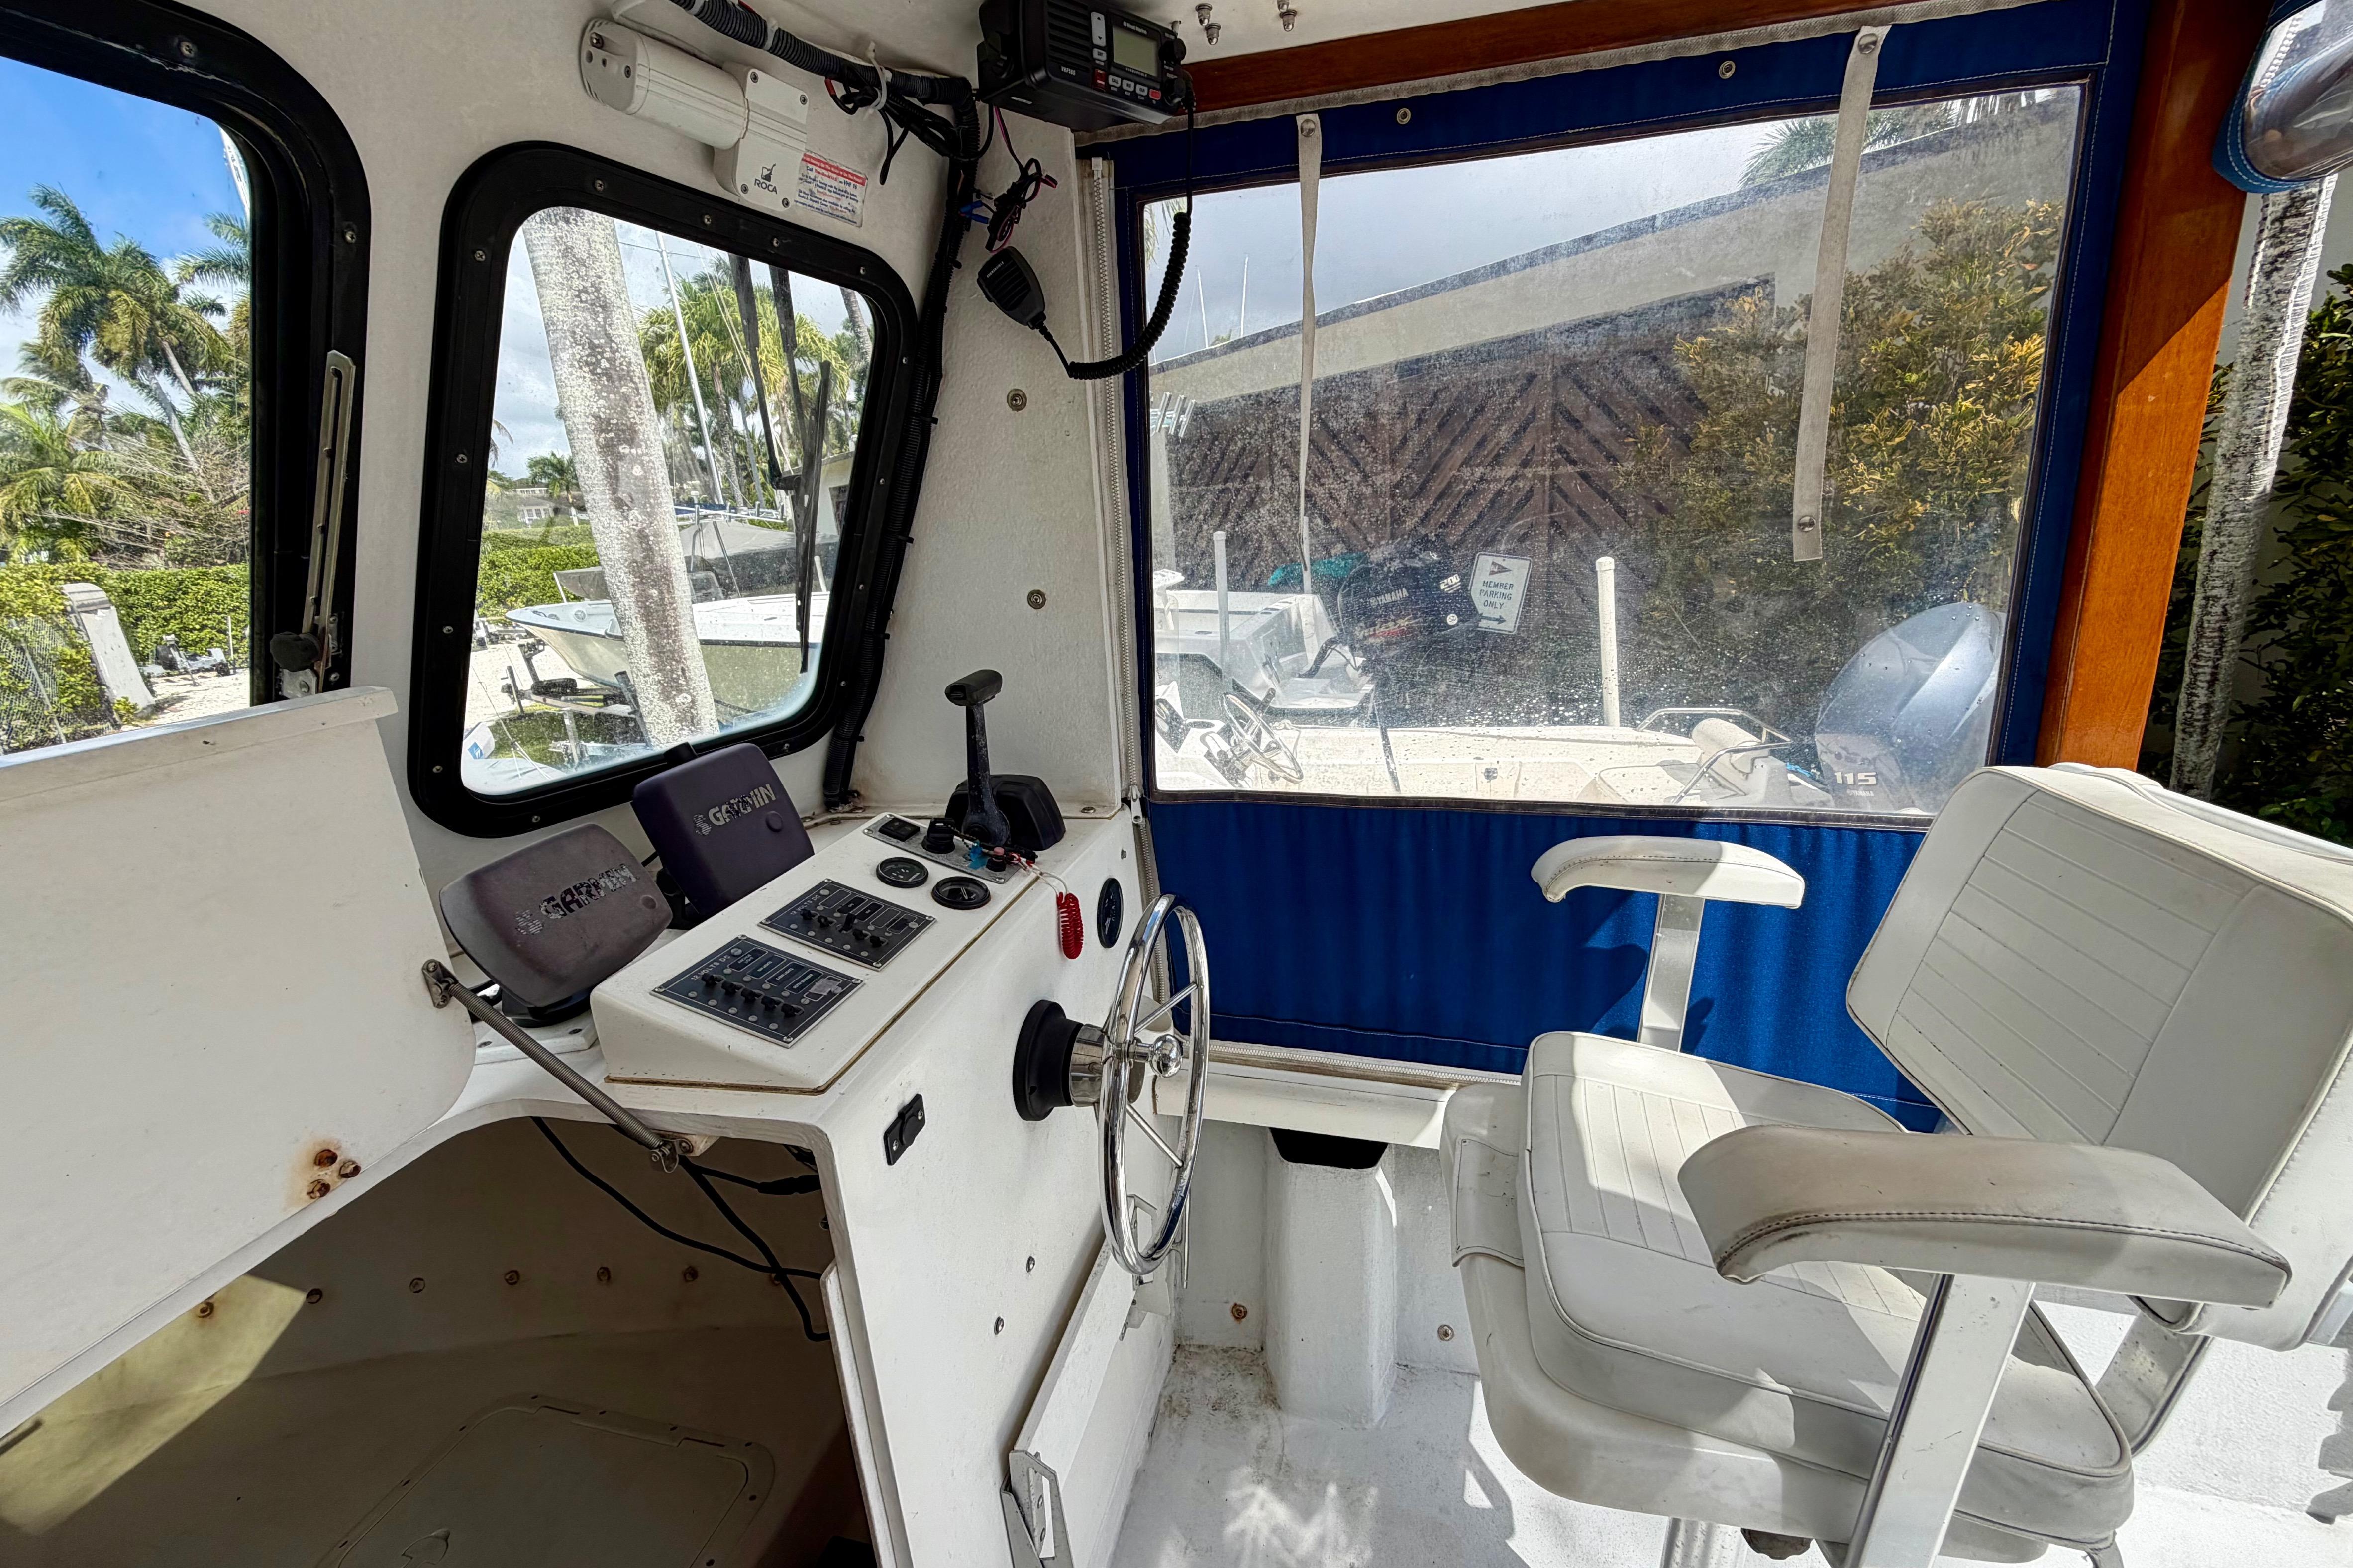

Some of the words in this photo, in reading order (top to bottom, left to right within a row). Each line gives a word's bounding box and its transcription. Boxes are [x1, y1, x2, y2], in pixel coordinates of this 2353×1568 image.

[754, 178, 777, 195] ROCA
[1439, 574, 1461, 589] 200
[1482, 580, 1514, 590] MEMBER
[1376, 588, 1409, 605] YAMAHA
[1479, 589, 1512, 601] PARKING
[1483, 600, 1505, 609] ONLY
[1834, 772, 1877, 785] 115
[708, 784, 777, 826] GARMIN
[539, 863, 638, 920] GARMIN
[796, 900, 813, 911] VOLTS
[698, 962, 720, 975] VOLTS
